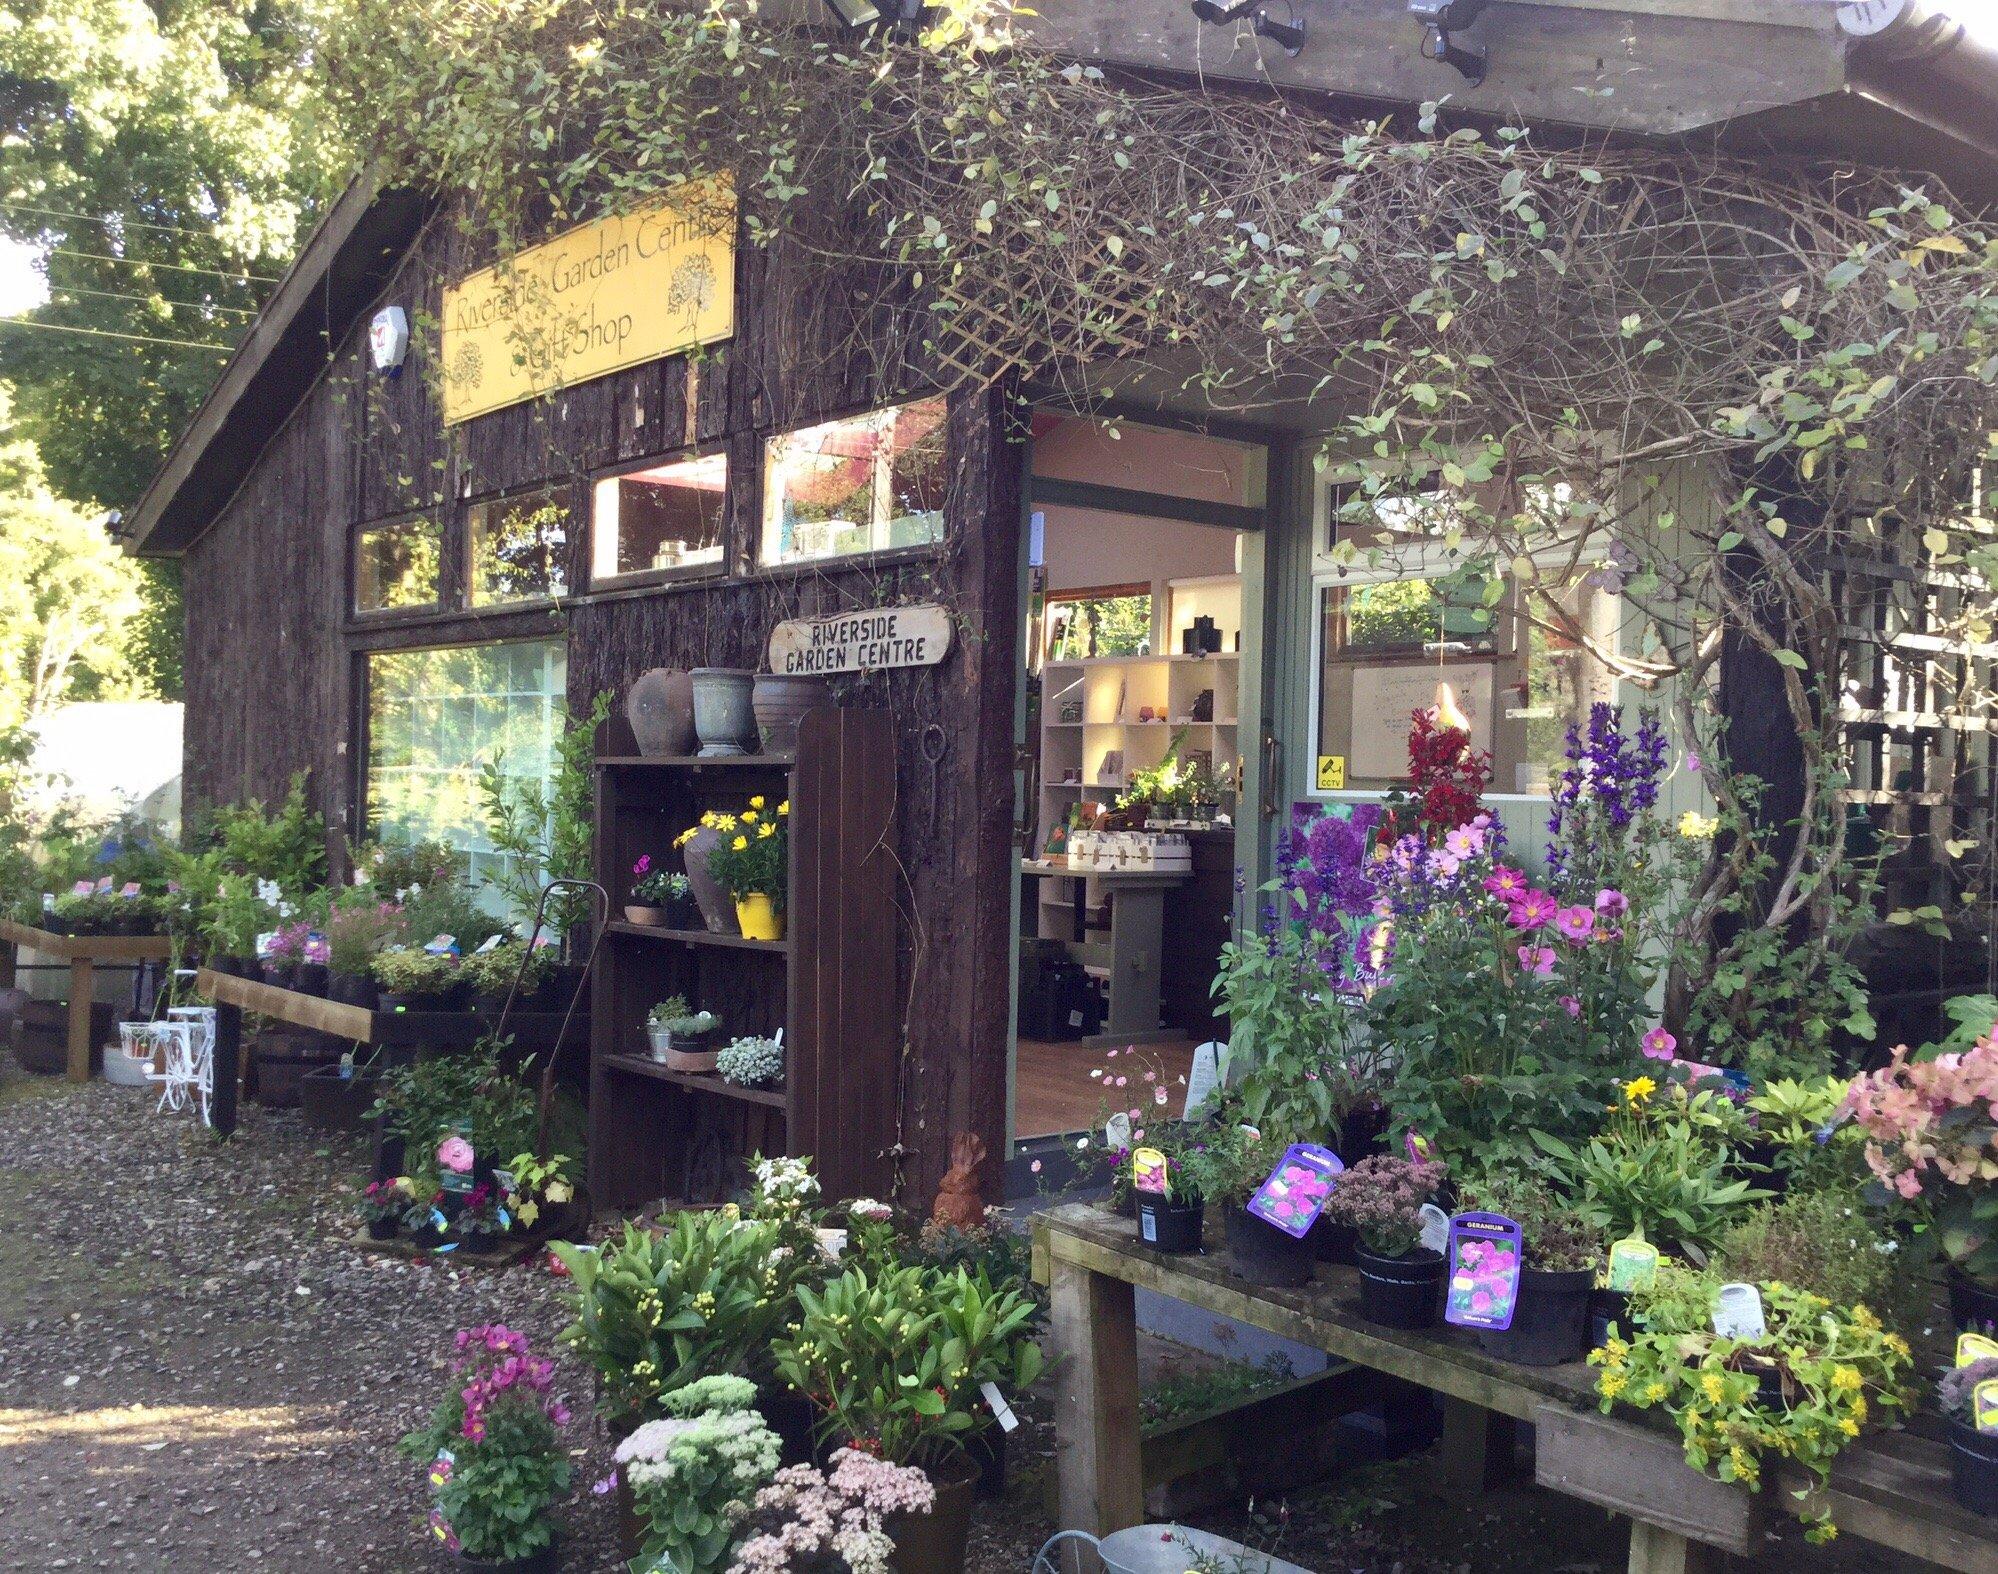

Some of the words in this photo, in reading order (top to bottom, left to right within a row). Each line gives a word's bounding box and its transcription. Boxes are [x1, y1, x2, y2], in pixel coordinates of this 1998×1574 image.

[457, 271, 541, 336] Riverde
[552, 229, 629, 293] Garden
[636, 213, 713, 259] Centr
[573, 303, 632, 355] Shop
[812, 615, 897, 647] RIVERSIDE
[786, 647, 847, 674] GARDEN
[857, 637, 926, 667] CENTRE
[1321, 779, 1341, 787] CCTV
[1466, 1221, 1505, 1232] GERANIUM
